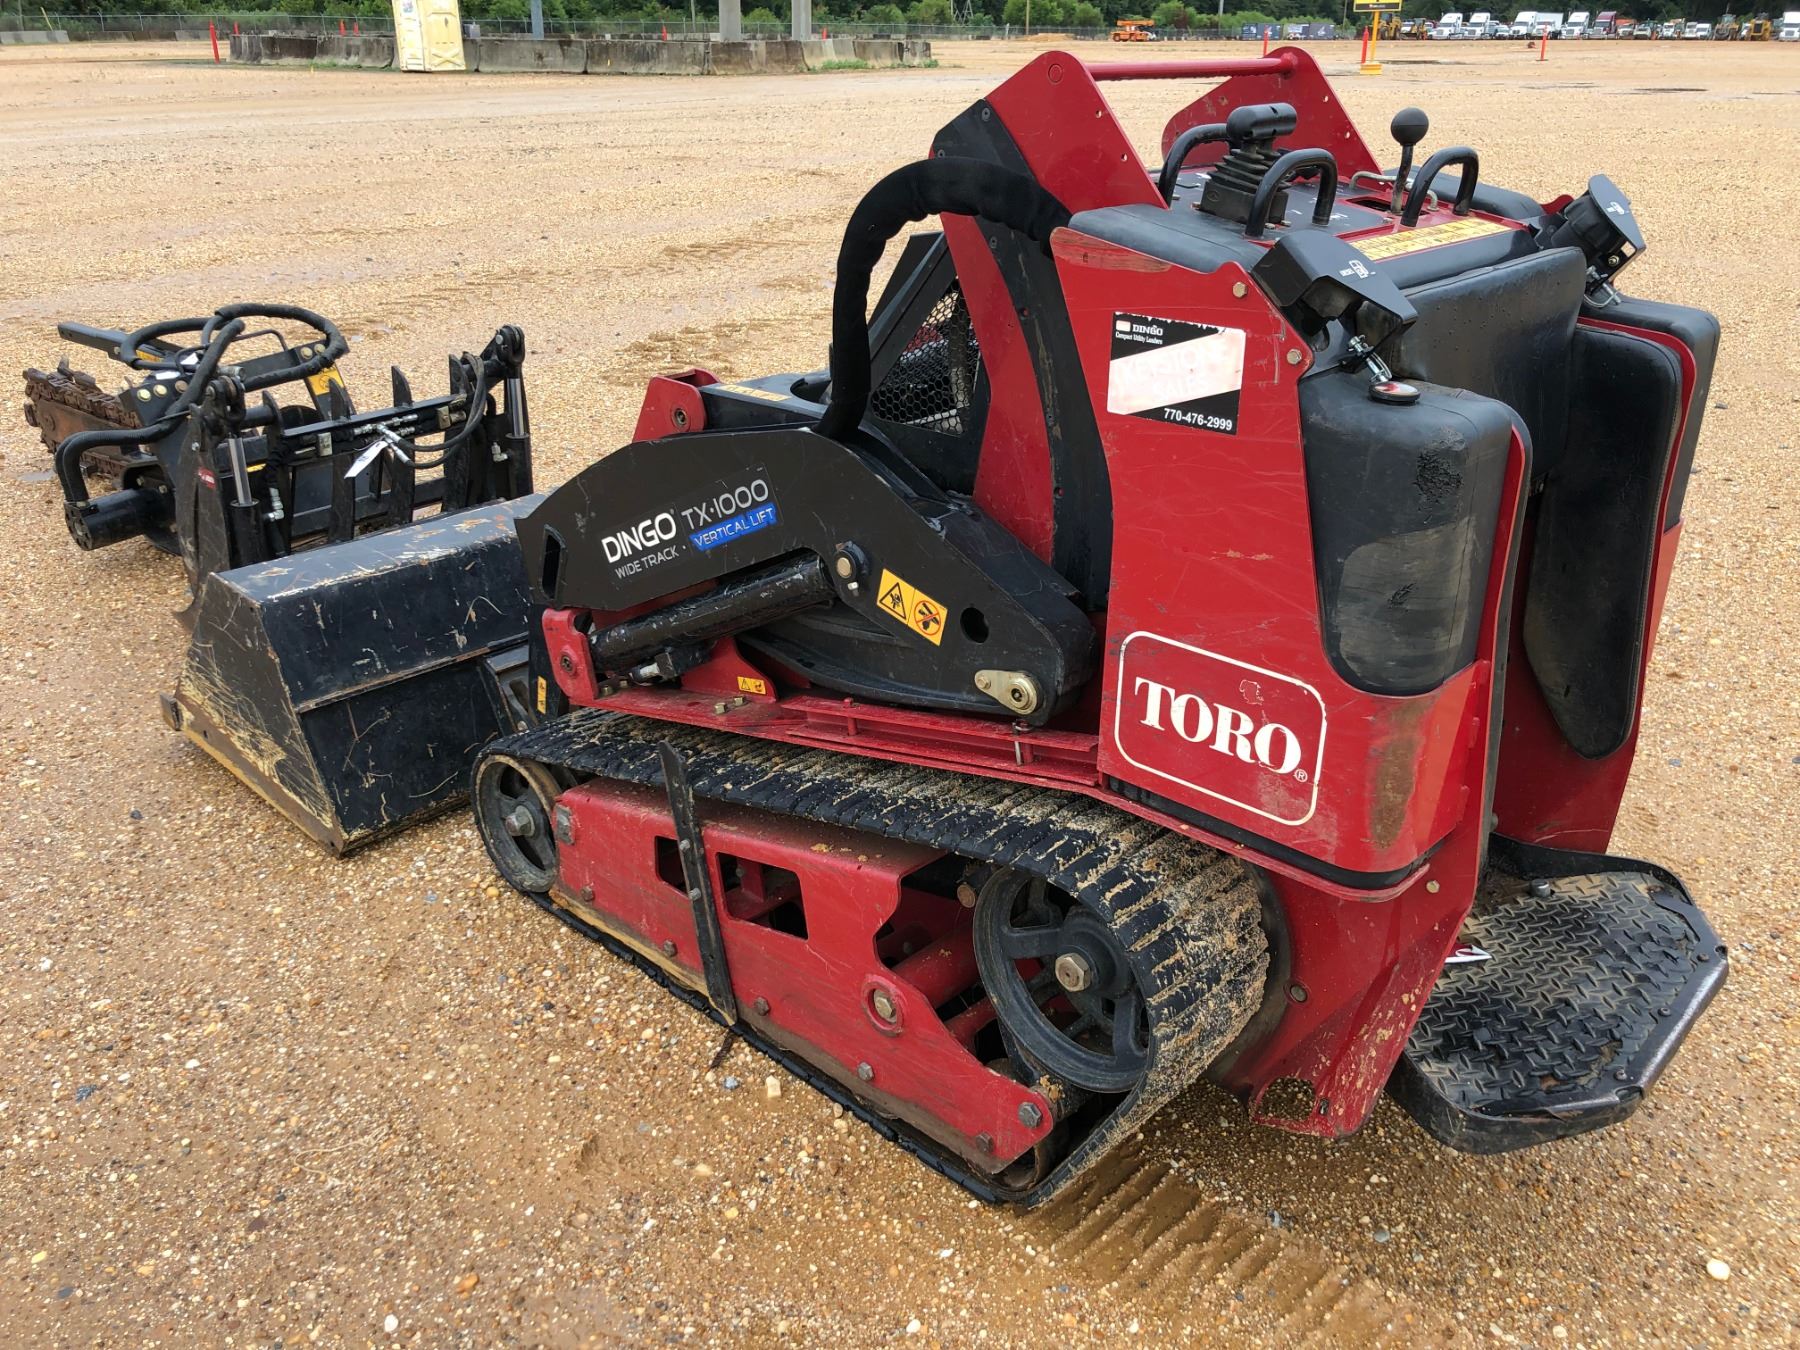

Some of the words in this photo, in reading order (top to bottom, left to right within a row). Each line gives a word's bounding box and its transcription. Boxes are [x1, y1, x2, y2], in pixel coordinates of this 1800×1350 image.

[1164, 408, 1233, 431] 770-476-2999
[601, 512, 677, 563] DINGO
[694, 519, 750, 547] VERTICAL
[751, 507, 774, 527] LIFT
[615, 561, 643, 580] WIDE
[642, 545, 680, 567] TRACK
